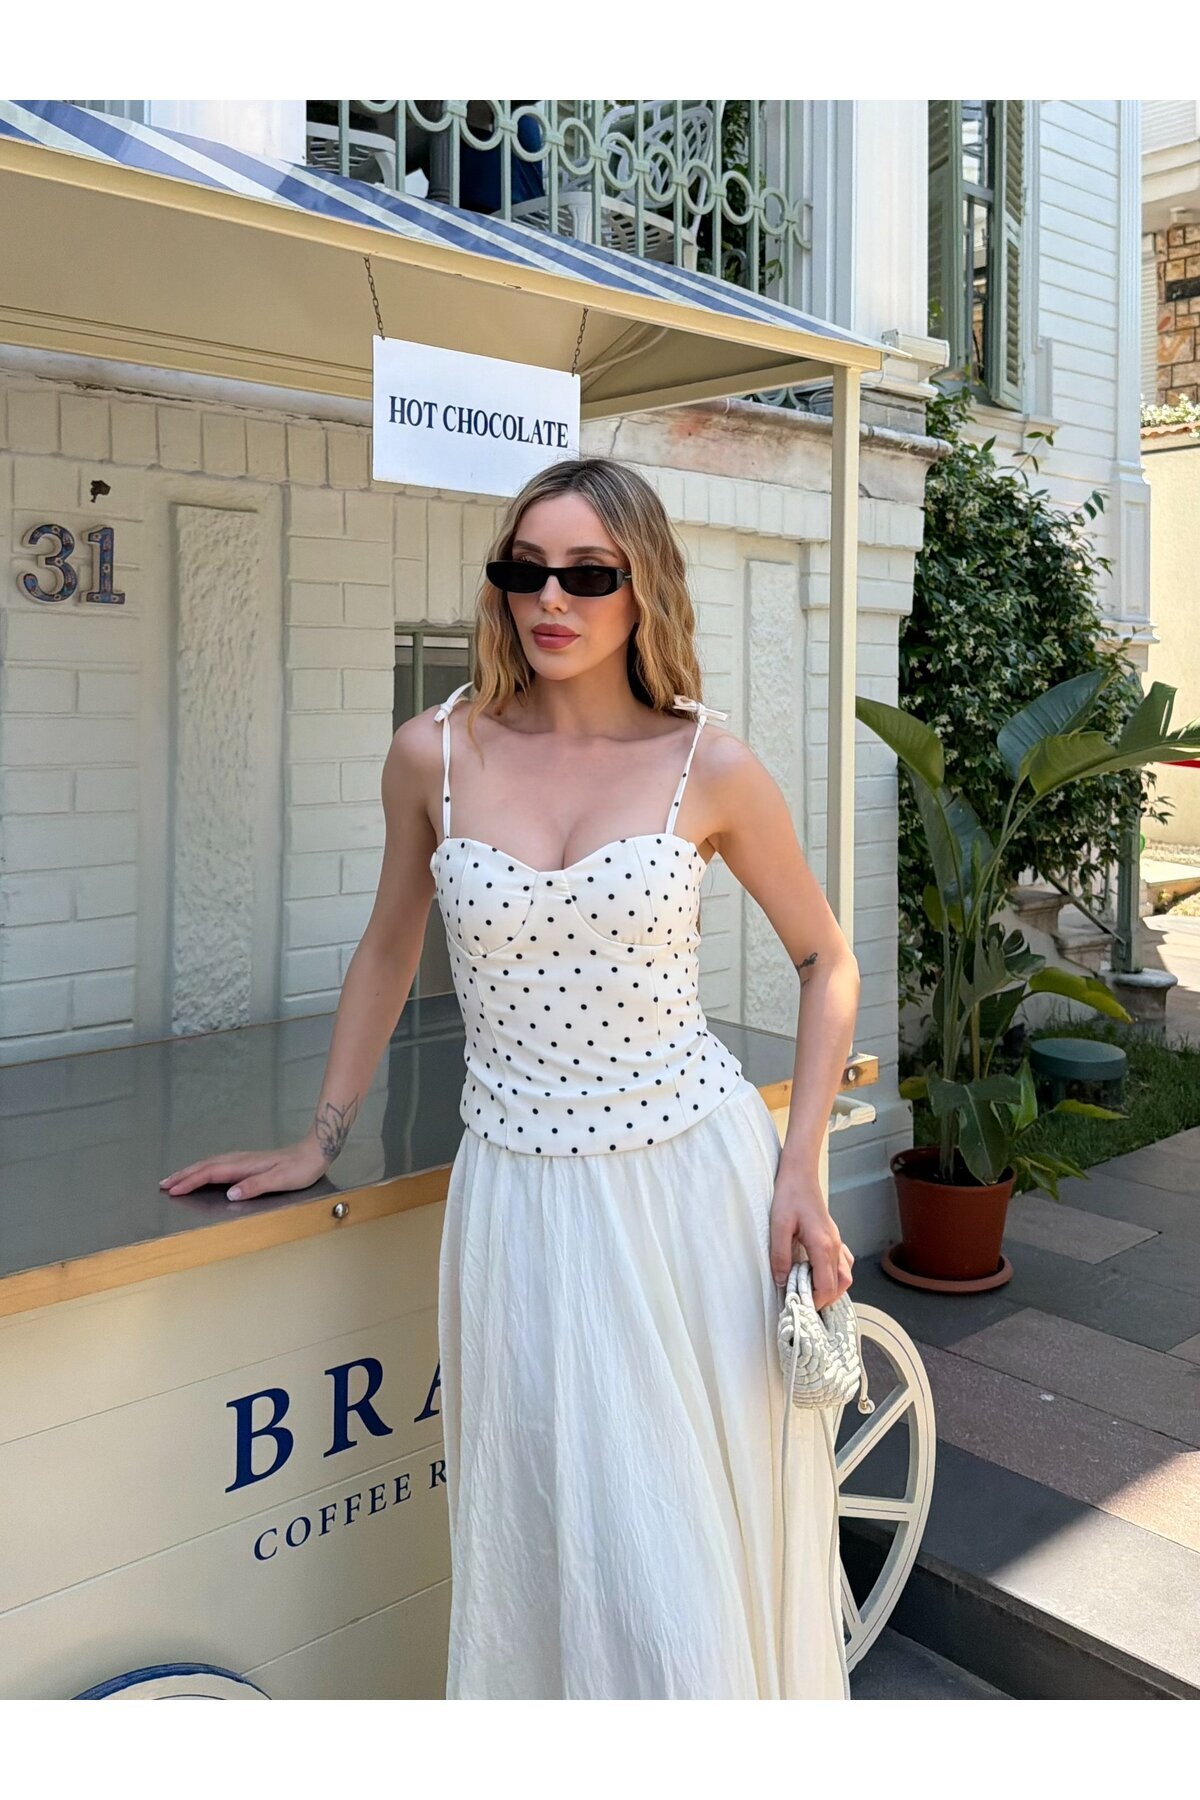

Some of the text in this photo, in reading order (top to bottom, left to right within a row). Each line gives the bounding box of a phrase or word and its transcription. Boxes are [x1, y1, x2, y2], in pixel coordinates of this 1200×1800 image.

[388, 395, 569, 448] HOT CHOCOLATE
[19, 523, 126, 605] 31
[253, 1473, 412, 1561] COFFEE
